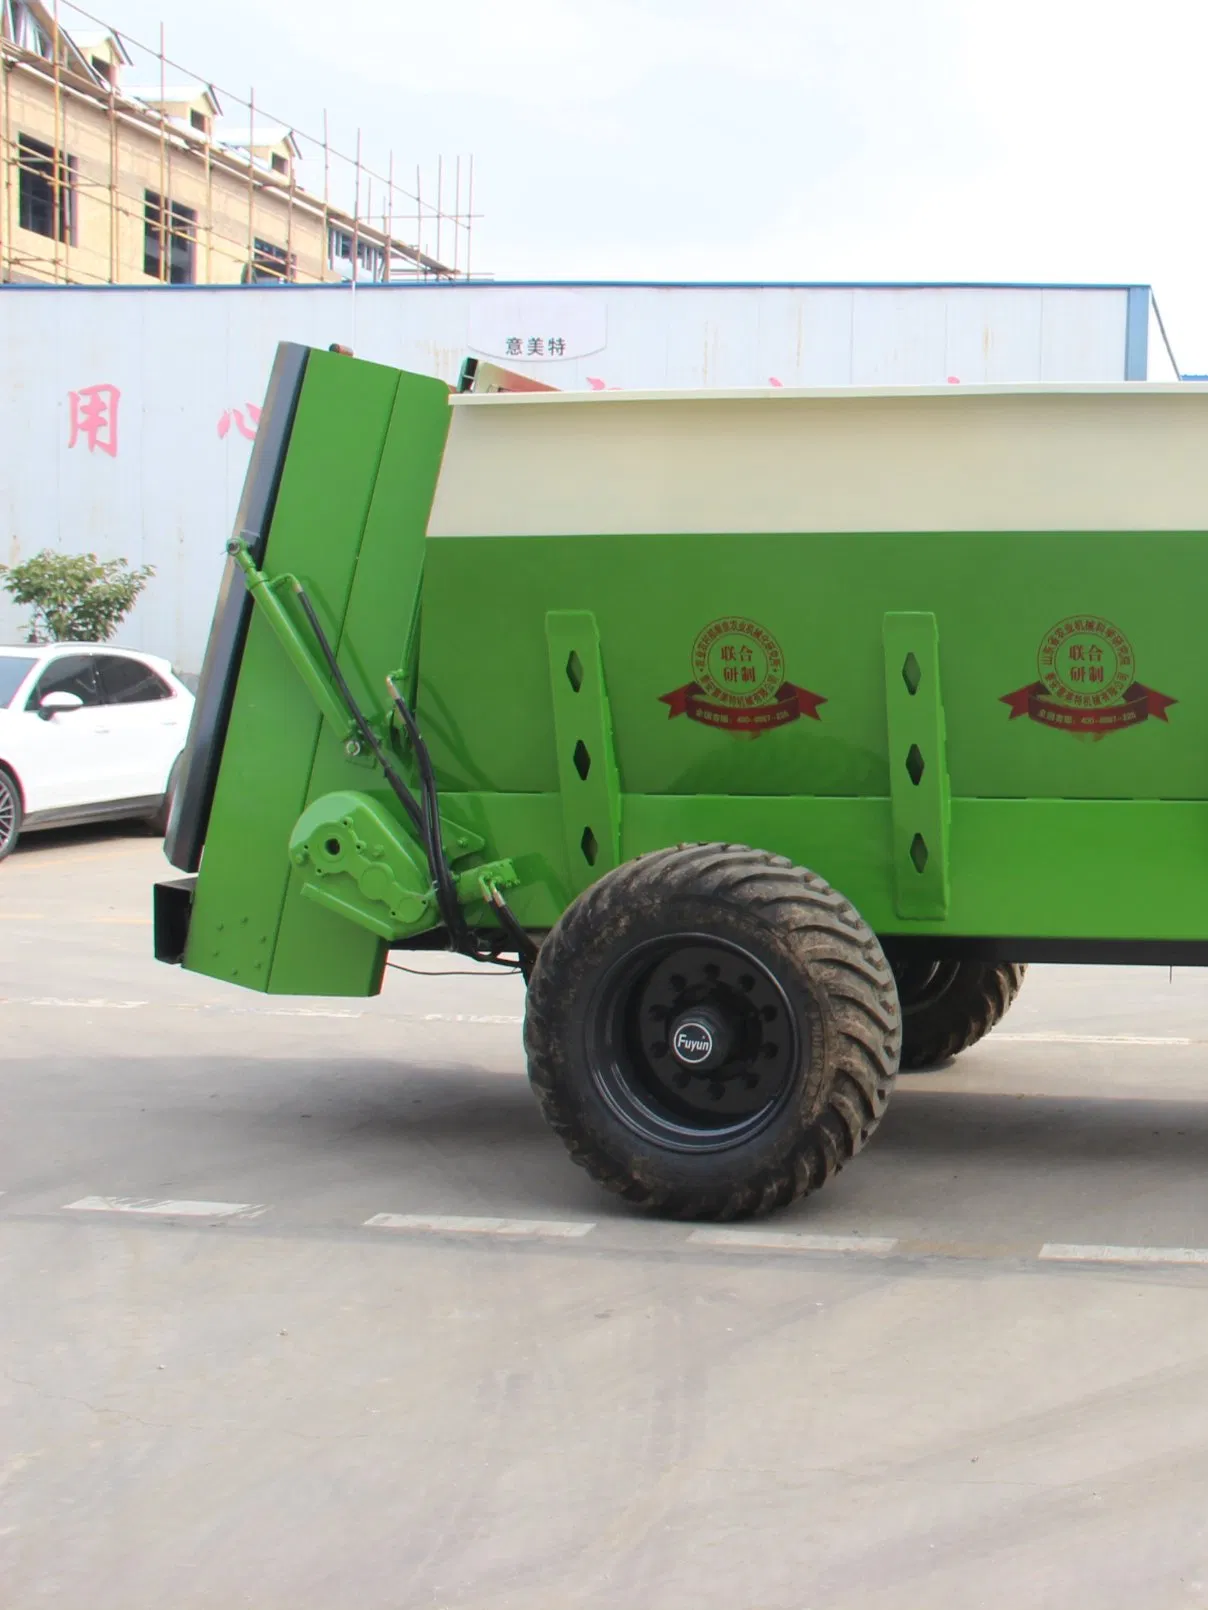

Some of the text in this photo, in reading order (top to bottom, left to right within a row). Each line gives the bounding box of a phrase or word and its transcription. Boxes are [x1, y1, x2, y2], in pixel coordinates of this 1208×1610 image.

[506, 337, 566, 356] 意美特
[720, 645, 753, 662] 联合
[1068, 644, 1104, 662] 联合
[723, 666, 756, 683] 研制
[1069, 665, 1104, 683] 研制
[677, 1033, 709, 1052] Fuyun
